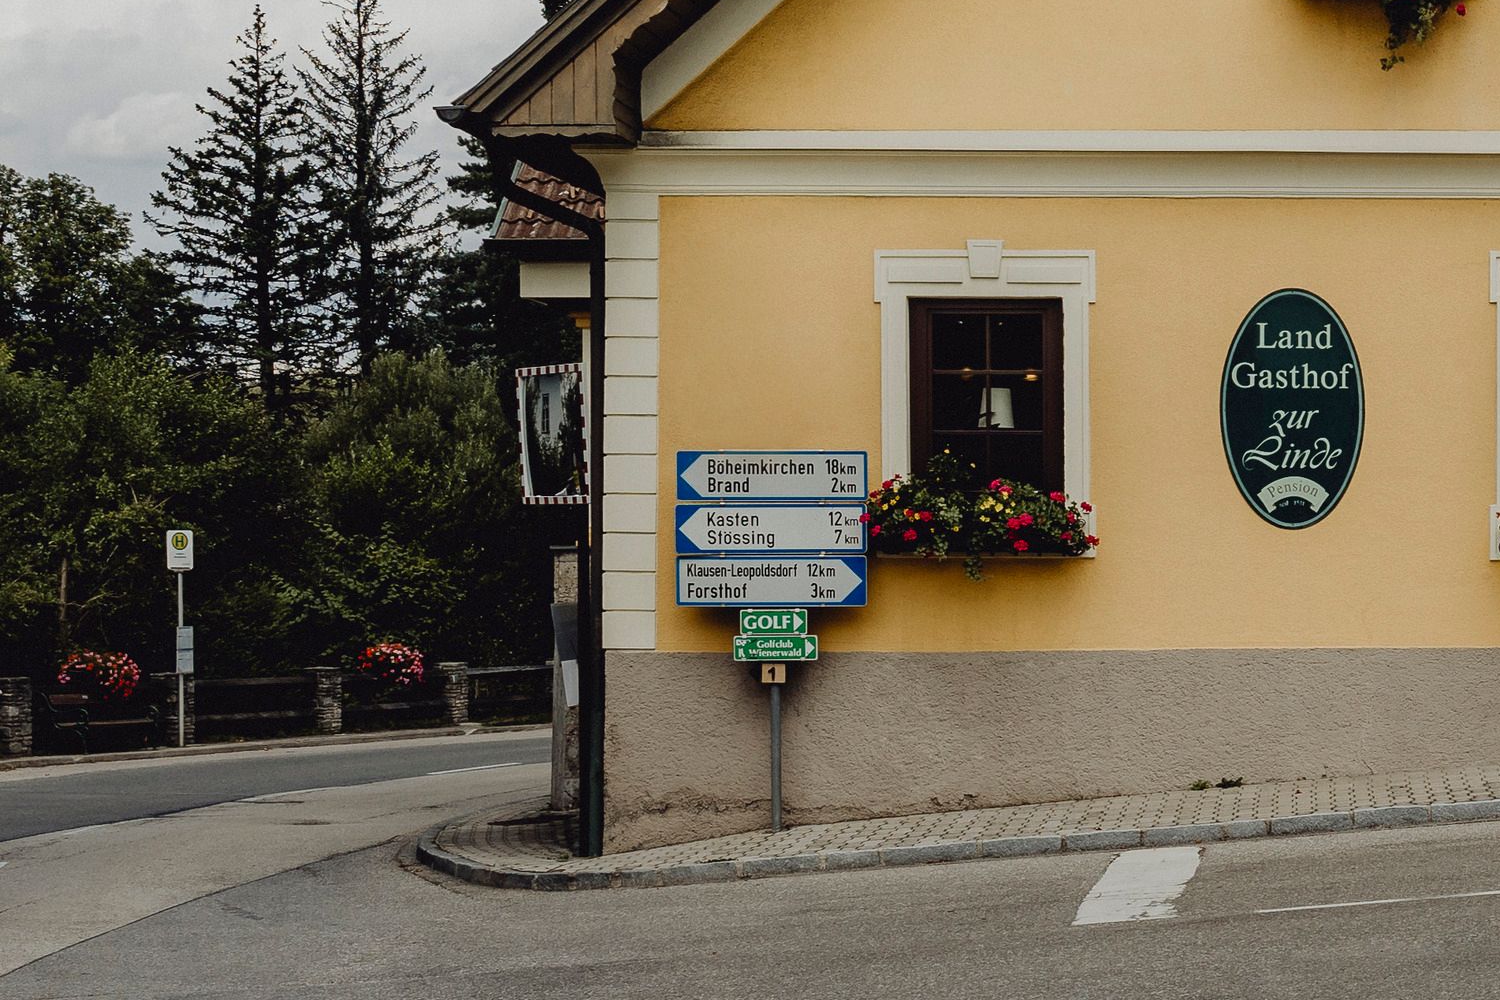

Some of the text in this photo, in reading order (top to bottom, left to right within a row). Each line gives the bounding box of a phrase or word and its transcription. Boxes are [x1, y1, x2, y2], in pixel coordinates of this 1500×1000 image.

[1256, 322, 1333, 350] Land
[1231, 362, 1354, 390] Gasthof
[1268, 409, 1320, 437] zur
[1241, 435, 1343, 471] Linde
[707, 459, 815, 475] Böheimkirchen
[708, 477, 750, 493] Brand
[1267, 480, 1319, 498] Pension
[707, 511, 859, 527] Kasten 12 km
[707, 529, 859, 548] Stössing 7 km
[686, 563, 798, 580] Klausen-Leopoldsdorf
[687, 583, 747, 598] Forsthof
[743, 615, 791, 630] GOLF
[756, 639, 793, 649] Golfclub
[749, 648, 802, 657] Wienerwald
[767, 666, 776, 682] 1
